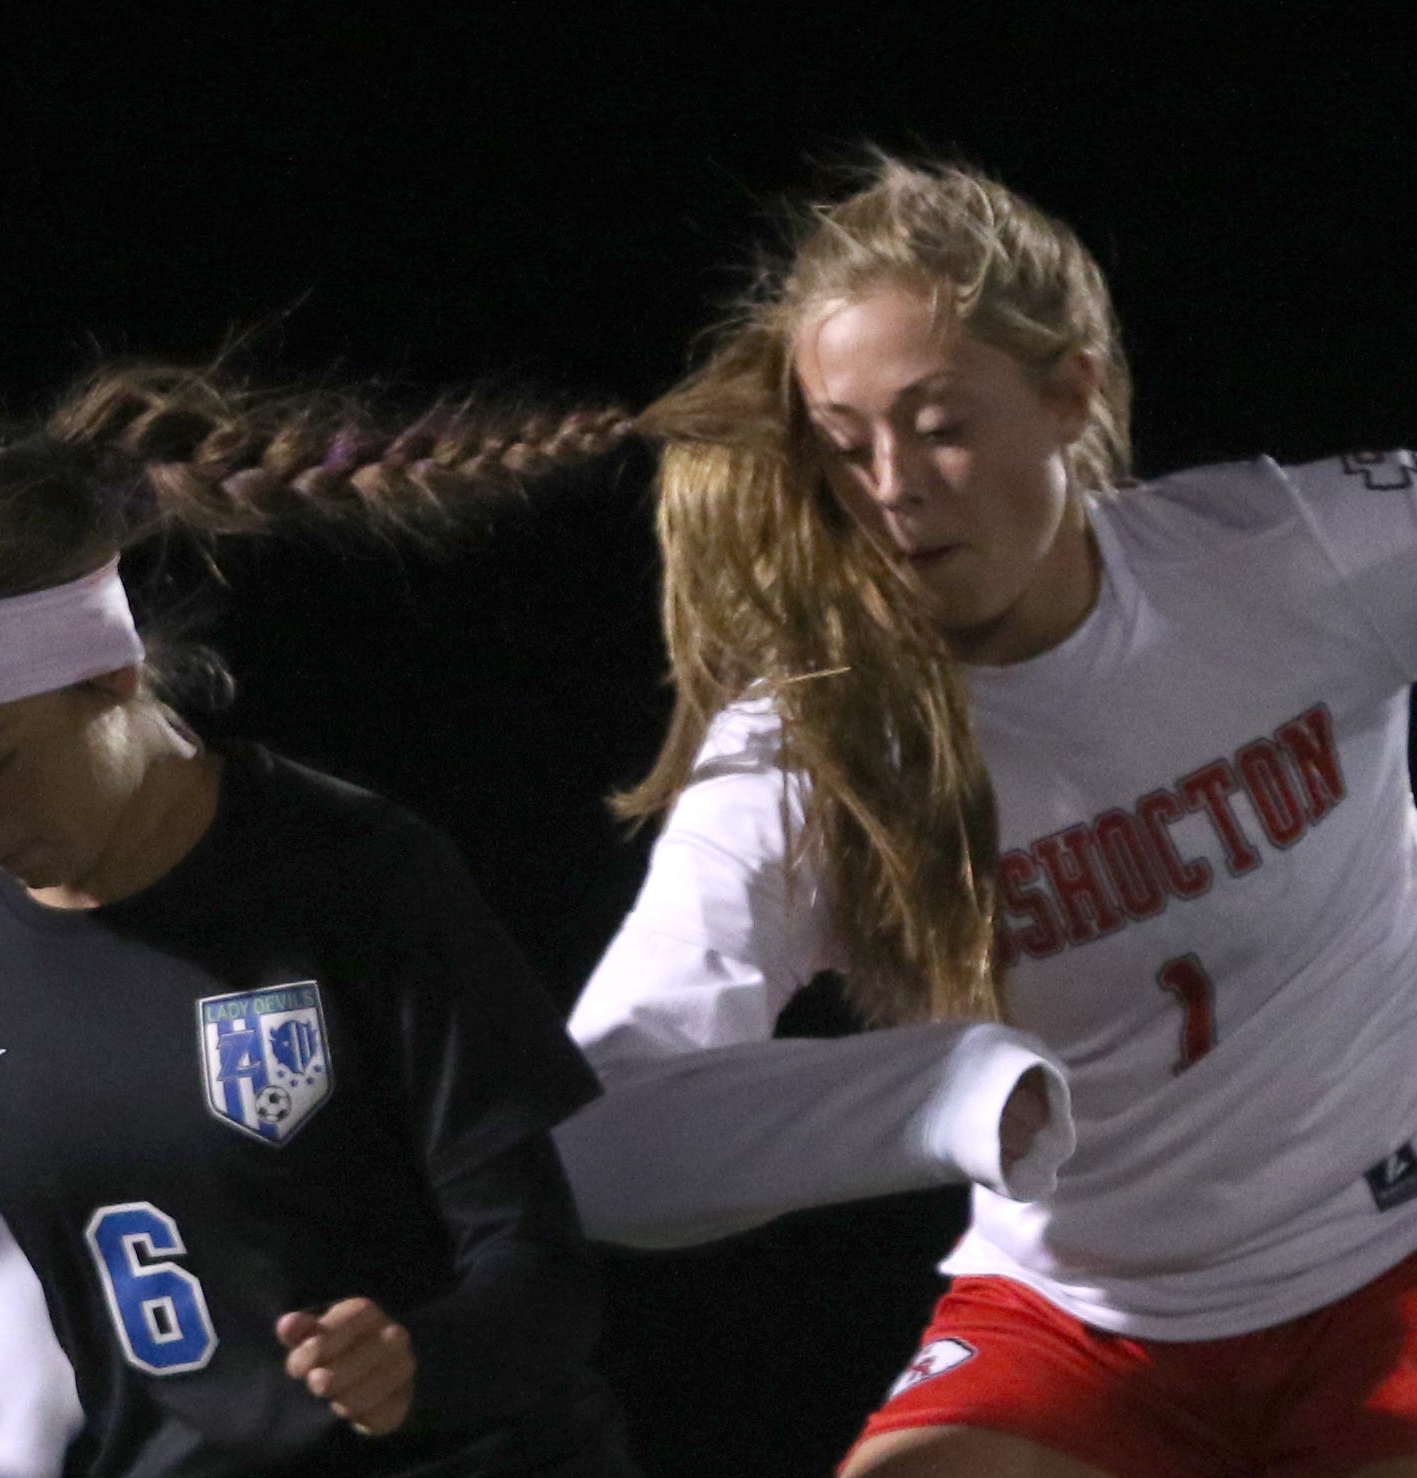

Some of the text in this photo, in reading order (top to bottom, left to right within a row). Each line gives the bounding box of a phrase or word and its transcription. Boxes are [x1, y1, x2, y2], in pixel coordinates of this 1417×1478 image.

[990, 702, 1348, 967] SHOCTON
[205, 988, 316, 1022] LADY DEVILS
[1155, 952, 1218, 1078] 1
[85, 1200, 219, 1377] 6
